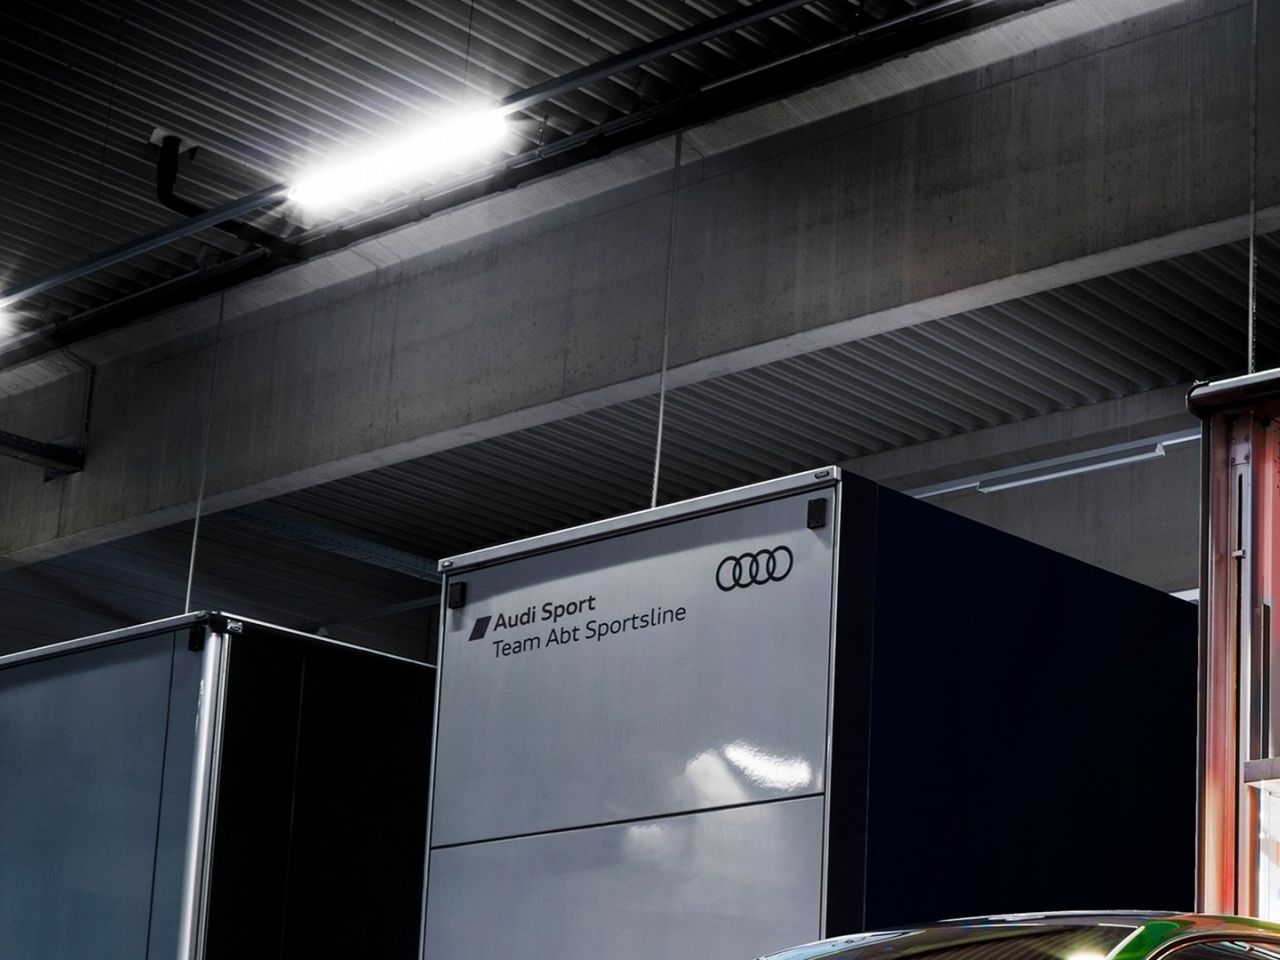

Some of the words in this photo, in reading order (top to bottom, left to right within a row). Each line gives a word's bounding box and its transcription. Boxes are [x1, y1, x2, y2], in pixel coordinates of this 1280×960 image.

[493, 605, 536, 632] Audi
[541, 594, 596, 624] Sport
[493, 636, 541, 658] Team
[545, 623, 580, 648] Abt
[585, 604, 687, 641] Sportsline
